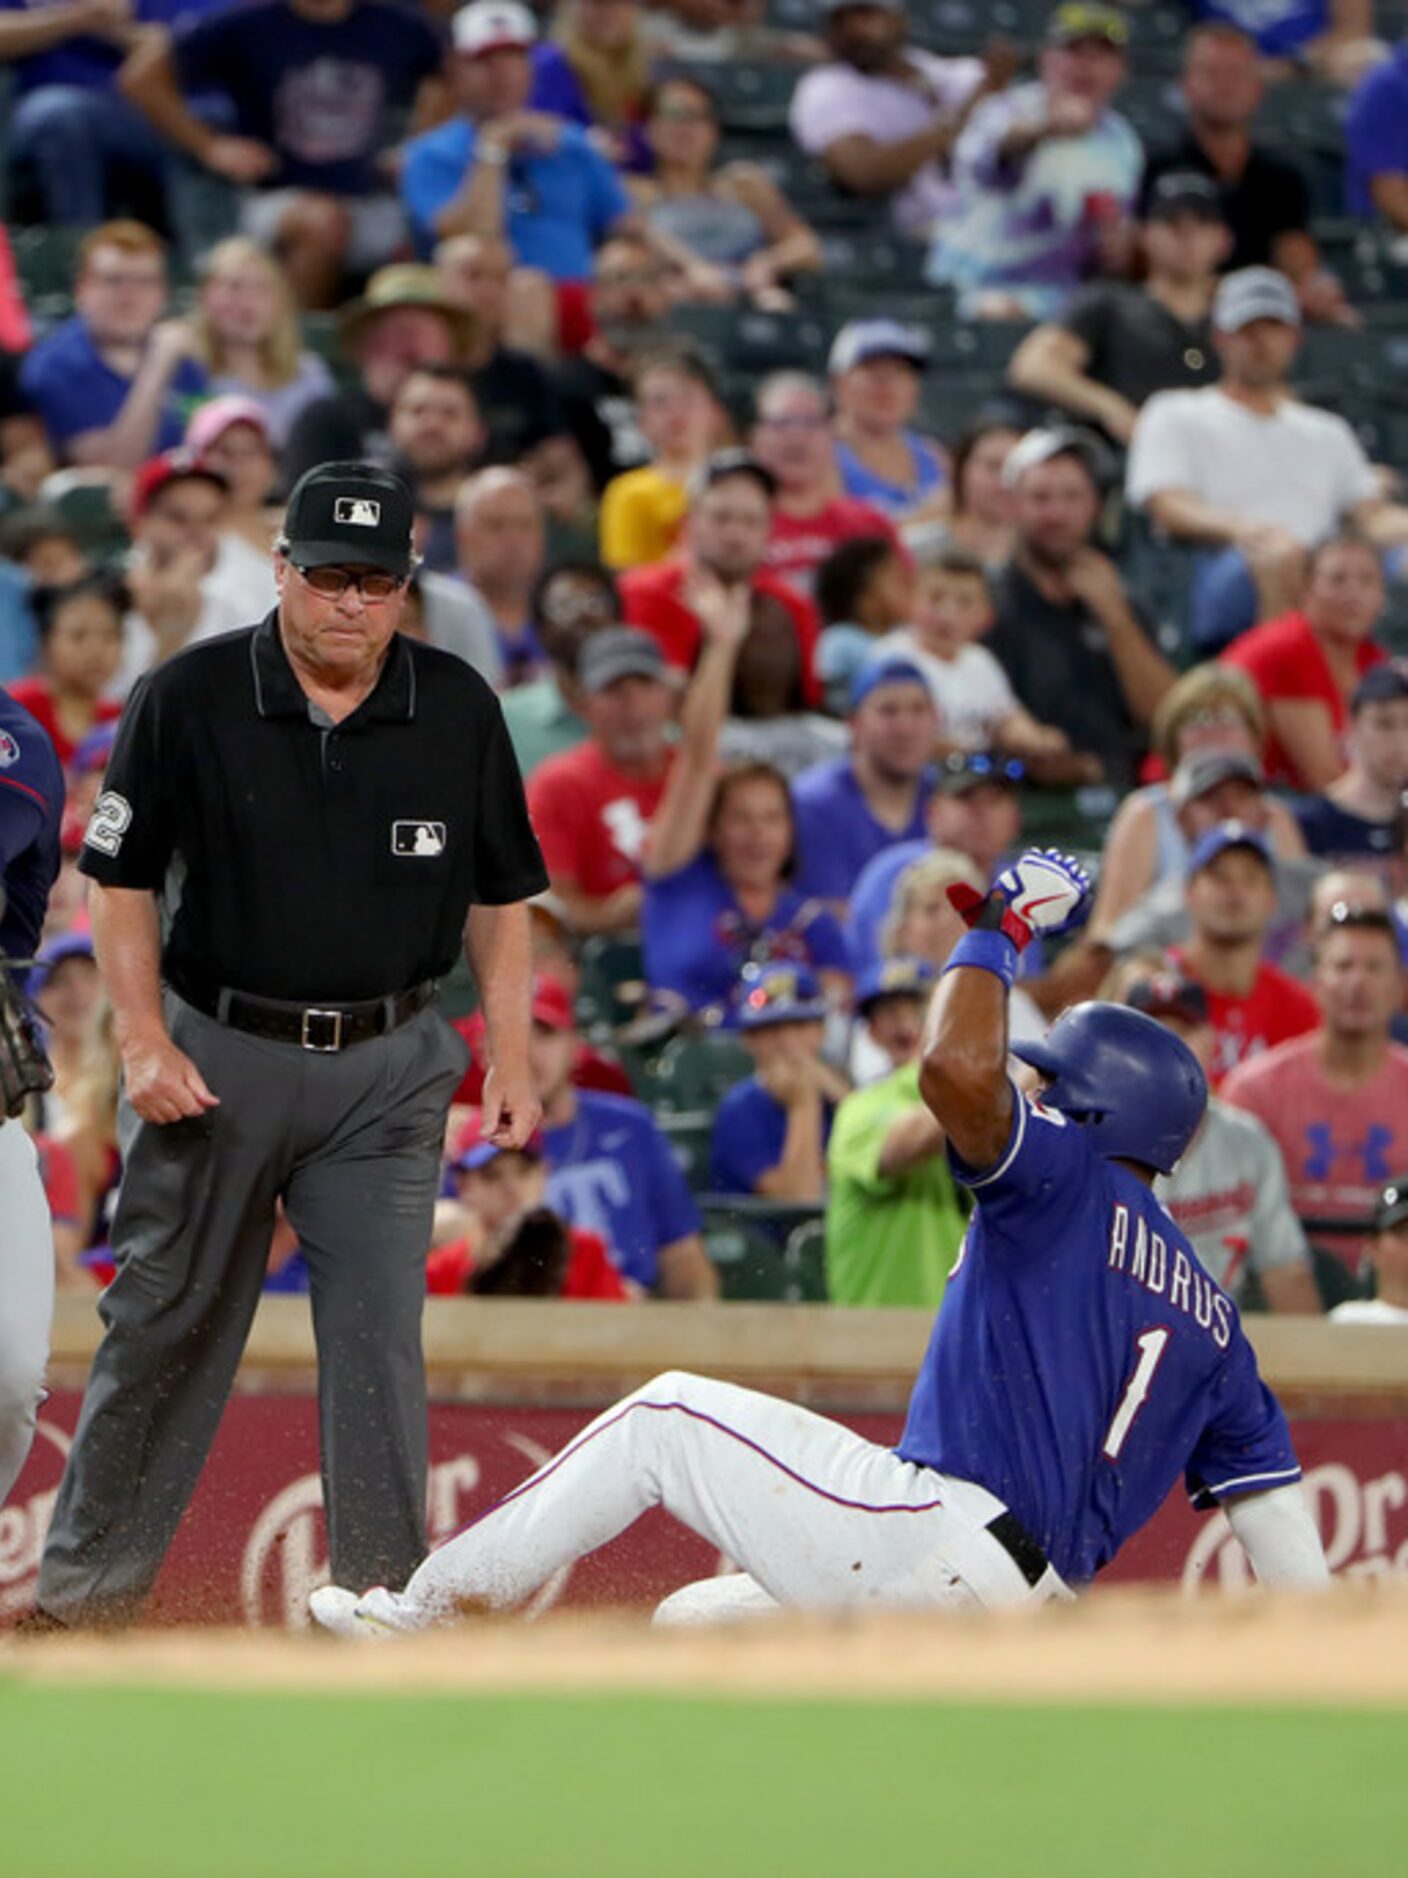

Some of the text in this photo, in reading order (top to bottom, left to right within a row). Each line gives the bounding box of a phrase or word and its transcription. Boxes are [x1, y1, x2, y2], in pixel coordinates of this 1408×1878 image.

[83, 790, 133, 858] 2
[1107, 1203, 1234, 1349] ANDRUS
[1101, 1325, 1171, 1464] 1
